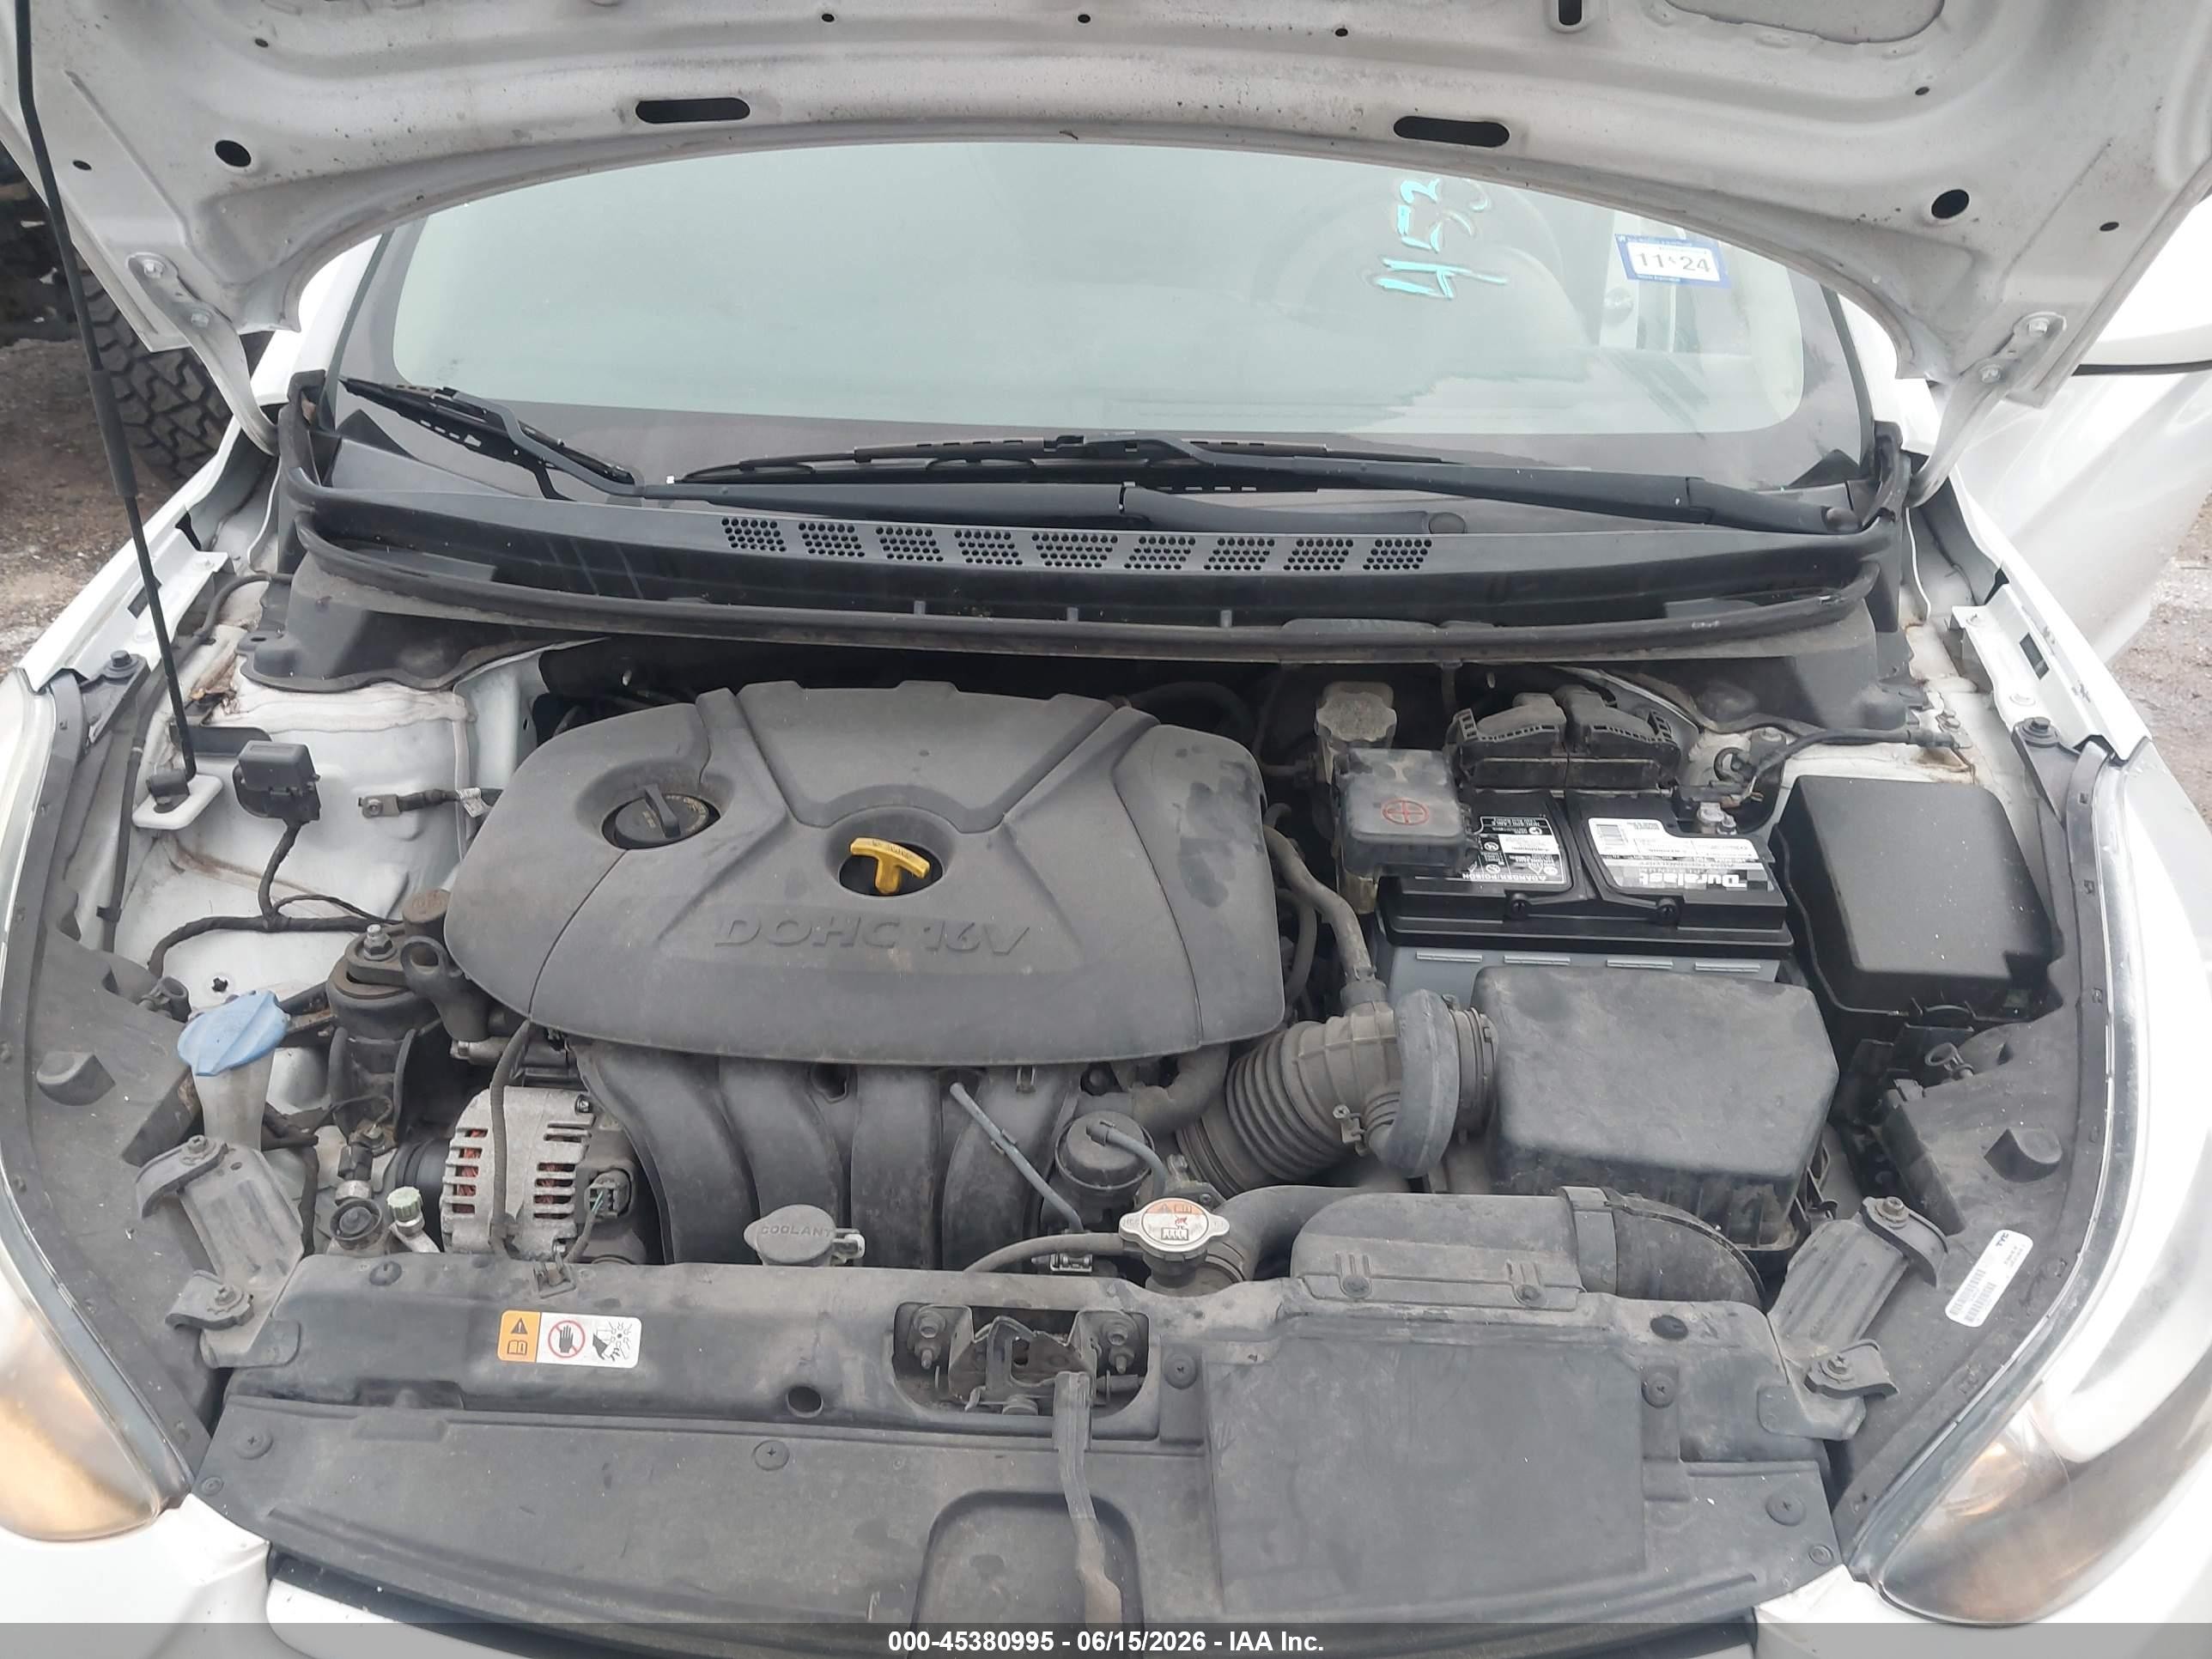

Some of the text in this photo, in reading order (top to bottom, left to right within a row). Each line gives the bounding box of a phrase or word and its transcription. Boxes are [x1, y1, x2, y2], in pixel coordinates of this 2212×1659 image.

[1636, 252, 1711, 273] 11 24
[1638, 872, 1748, 889] Duralast
[714, 915, 1031, 957] DOHC 16V
[760, 1224, 833, 1237] COOLANT
